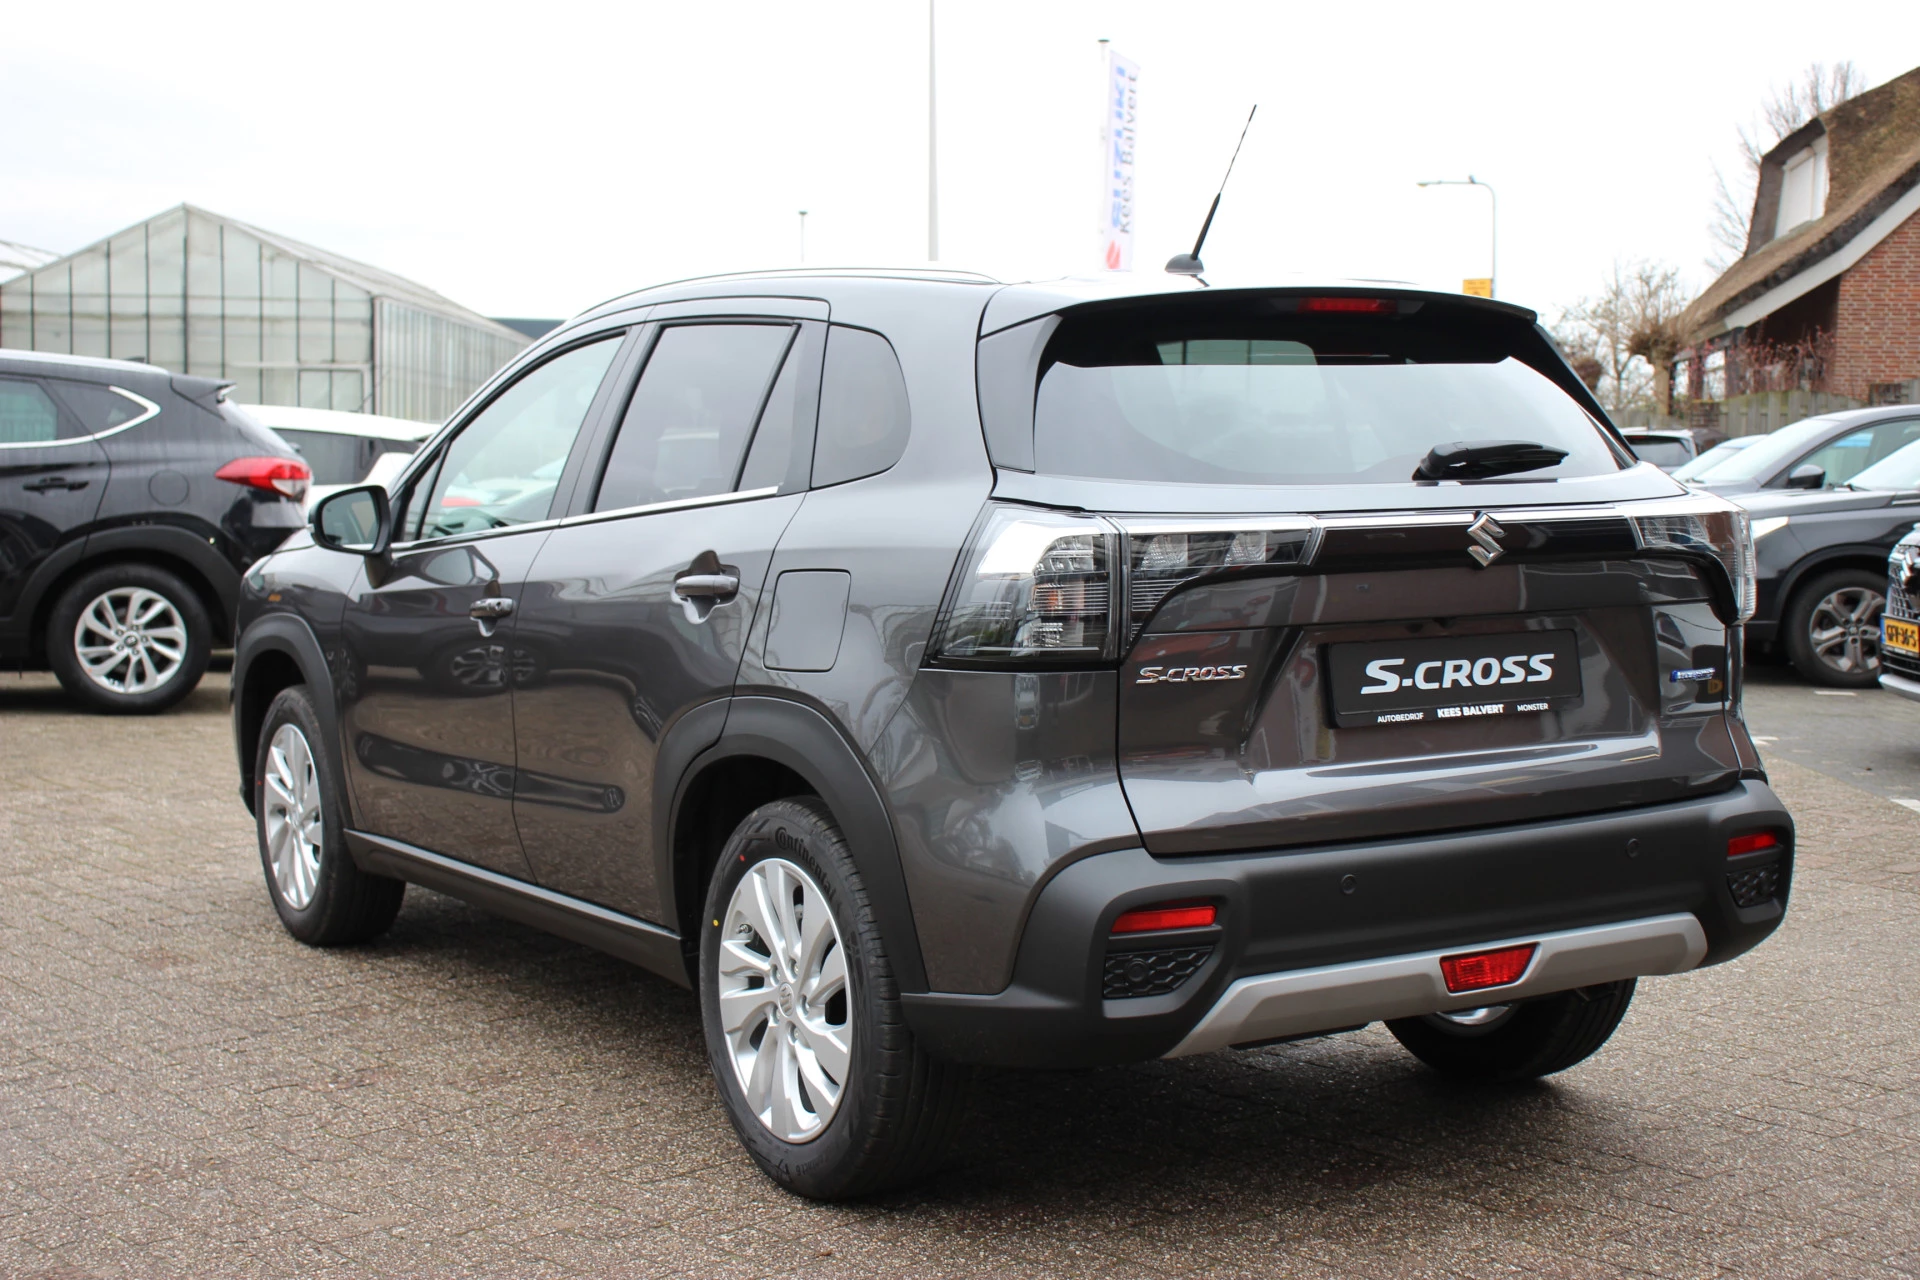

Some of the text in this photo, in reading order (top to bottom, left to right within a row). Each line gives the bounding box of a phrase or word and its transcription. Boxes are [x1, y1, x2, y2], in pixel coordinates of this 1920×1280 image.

[1120, 74, 1137, 235] Kees Balvert
[1135, 664, 1248, 684] S-CROSS
[1360, 653, 1555, 695] S-CROSS
[1376, 702, 1549, 723] AUTOBEDRIJF KEES BALVERT MONSTER
[775, 826, 837, 903] Continental
